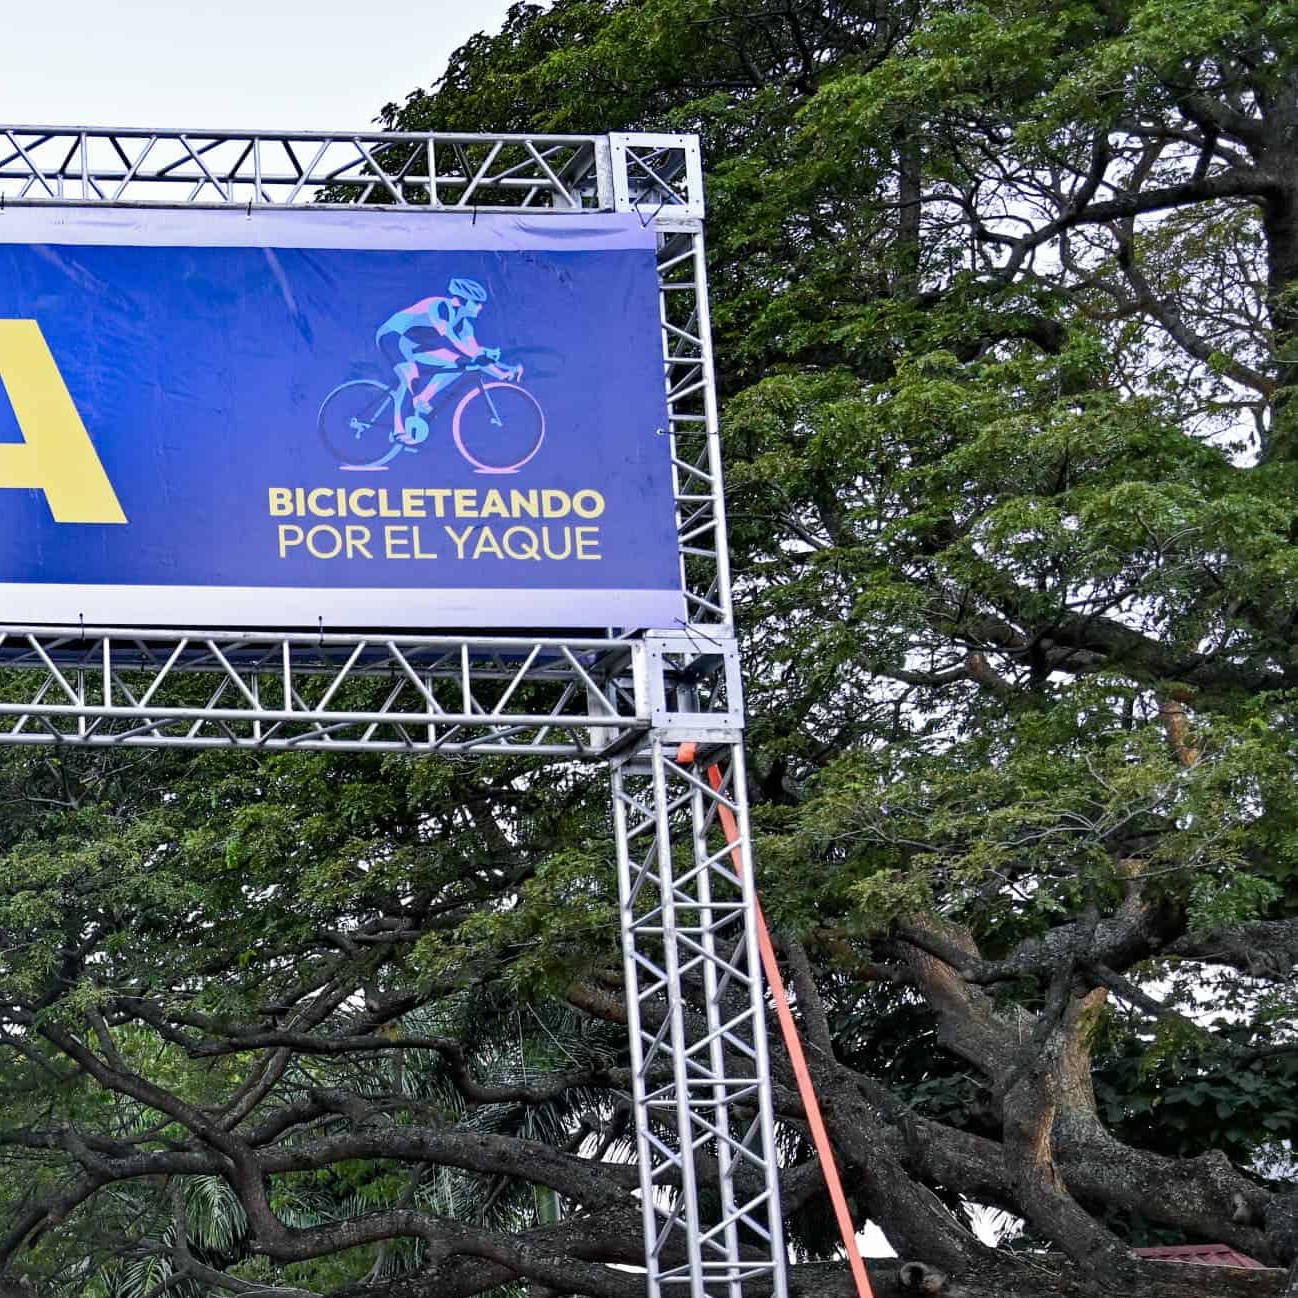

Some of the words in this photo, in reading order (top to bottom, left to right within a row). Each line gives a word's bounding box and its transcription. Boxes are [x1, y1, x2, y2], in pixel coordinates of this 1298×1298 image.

[268, 487, 605, 520] BICICLETEANDO
[278, 524, 373, 559] POR
[385, 526, 437, 560] EL
[445, 526, 602, 562] YAQUE
